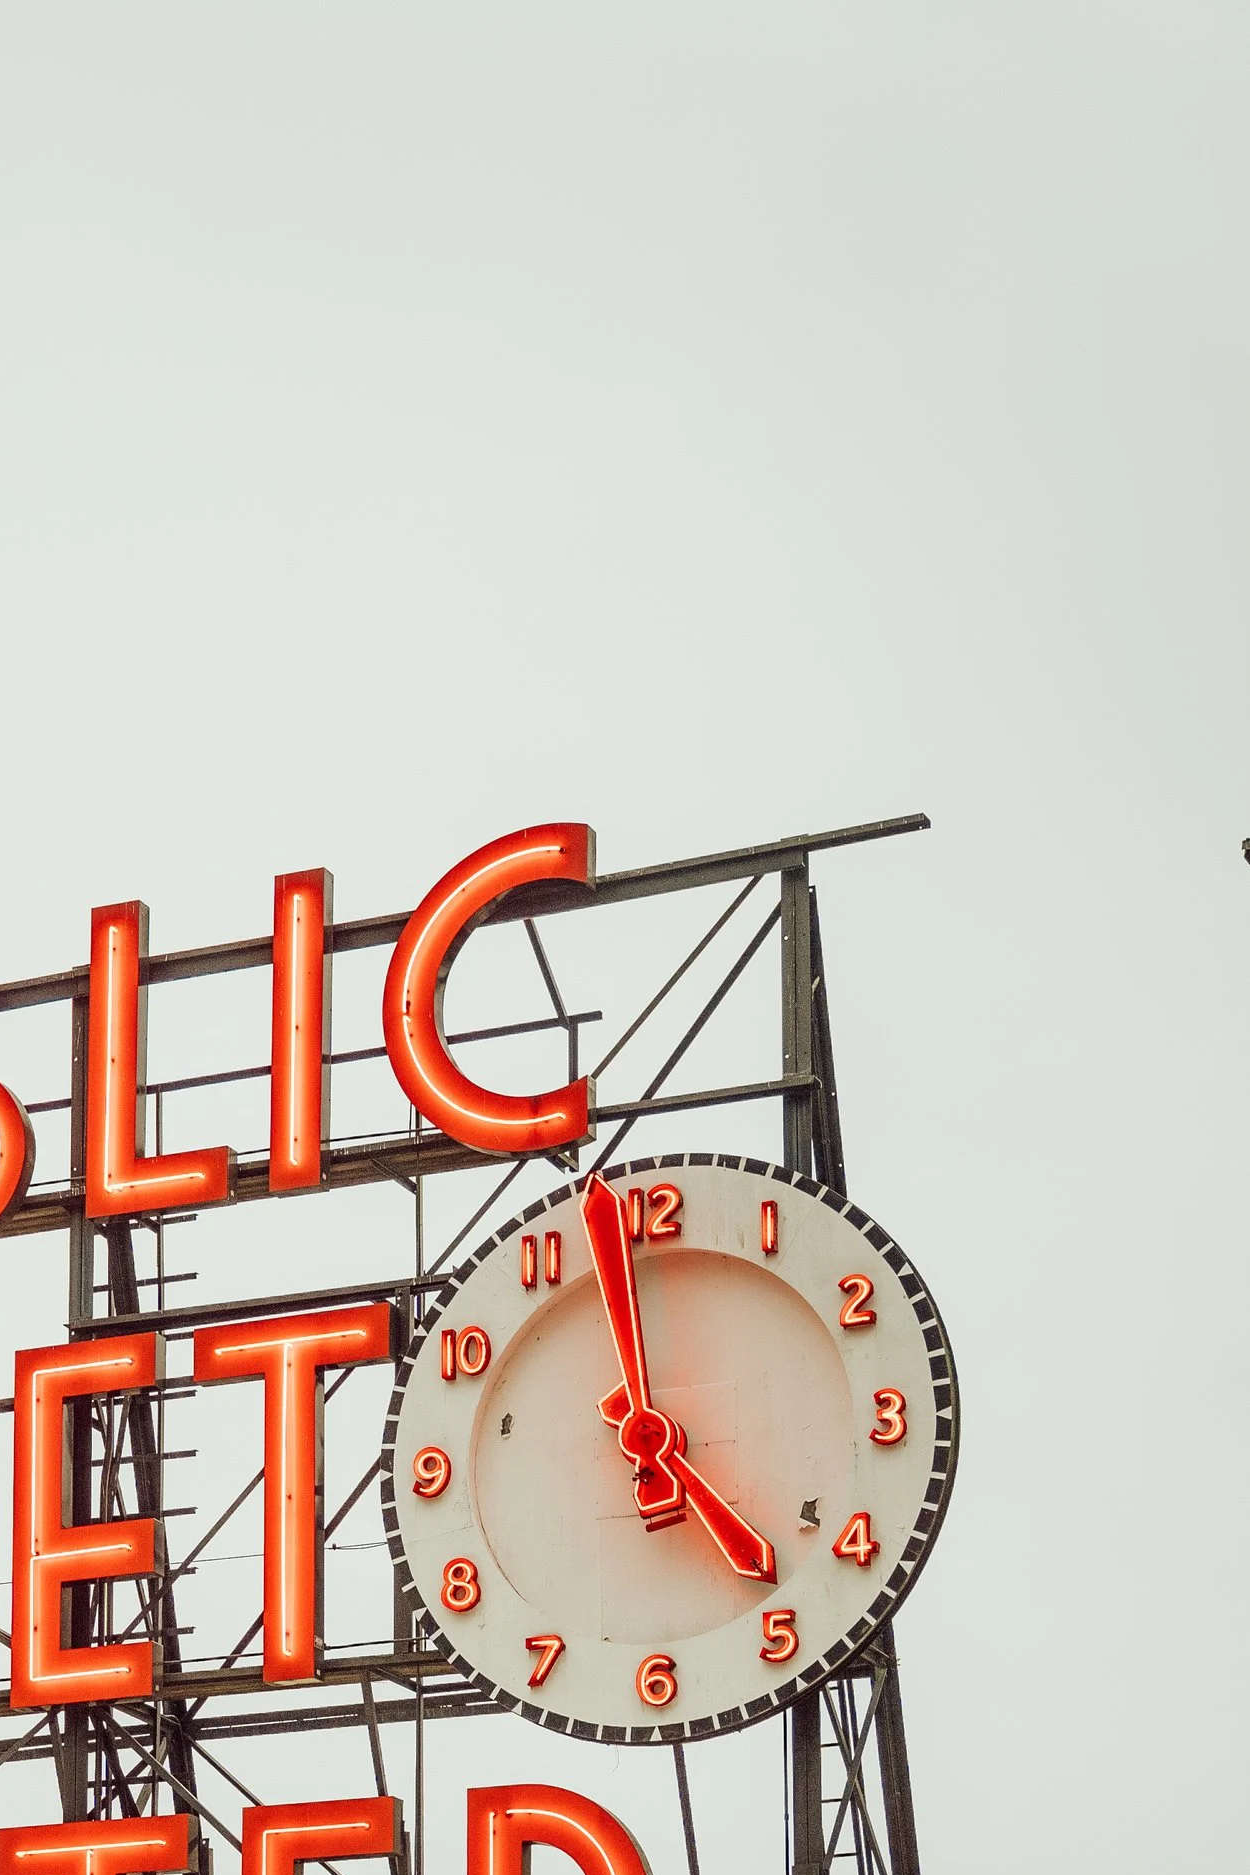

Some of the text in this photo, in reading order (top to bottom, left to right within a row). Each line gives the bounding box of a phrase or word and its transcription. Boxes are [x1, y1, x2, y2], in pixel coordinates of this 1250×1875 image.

[628, 1184, 683, 1241] 12
[761, 1200, 779, 1254] 1
[521, 1230, 561, 1288] 11
[837, 1274, 877, 1329] 2
[441, 1325, 491, 1381] 10
[869, 1388, 907, 1445] 3
[413, 1446, 452, 1499] 9
[832, 1512, 879, 1567] 4
[441, 1558, 481, 1612] 8
[526, 1634, 566, 1688] 7
[759, 1609, 800, 1663] 5
[636, 1654, 678, 1707] 6
